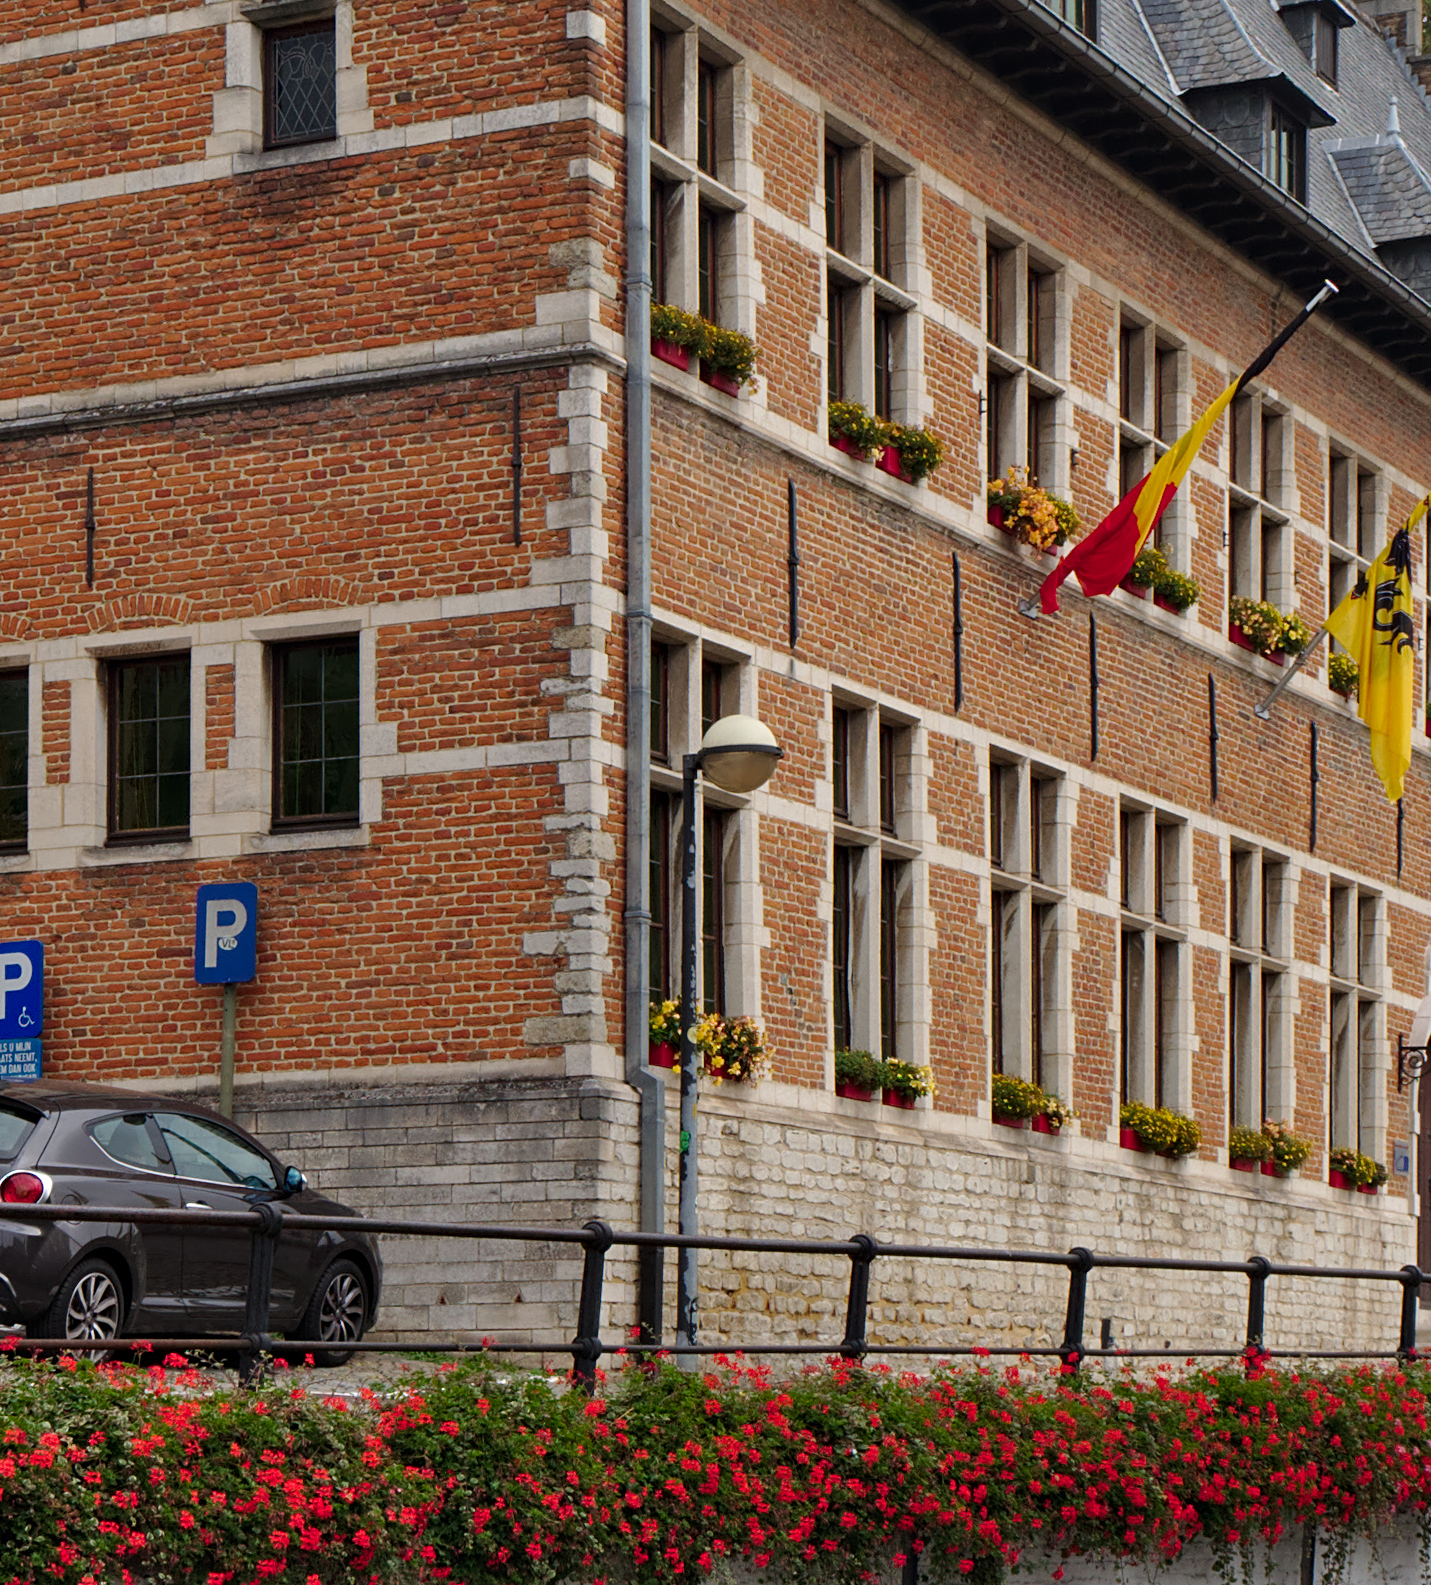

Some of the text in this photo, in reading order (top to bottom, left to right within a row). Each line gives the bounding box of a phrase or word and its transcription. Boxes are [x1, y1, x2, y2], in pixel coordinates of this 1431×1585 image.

[204, 899, 248, 968] P
[9, 1042, 15, 1052] U
[16, 1041, 31, 1052] MIJN
[8, 1063, 22, 1073] DAN
[23, 1063, 36, 1073] OOK
